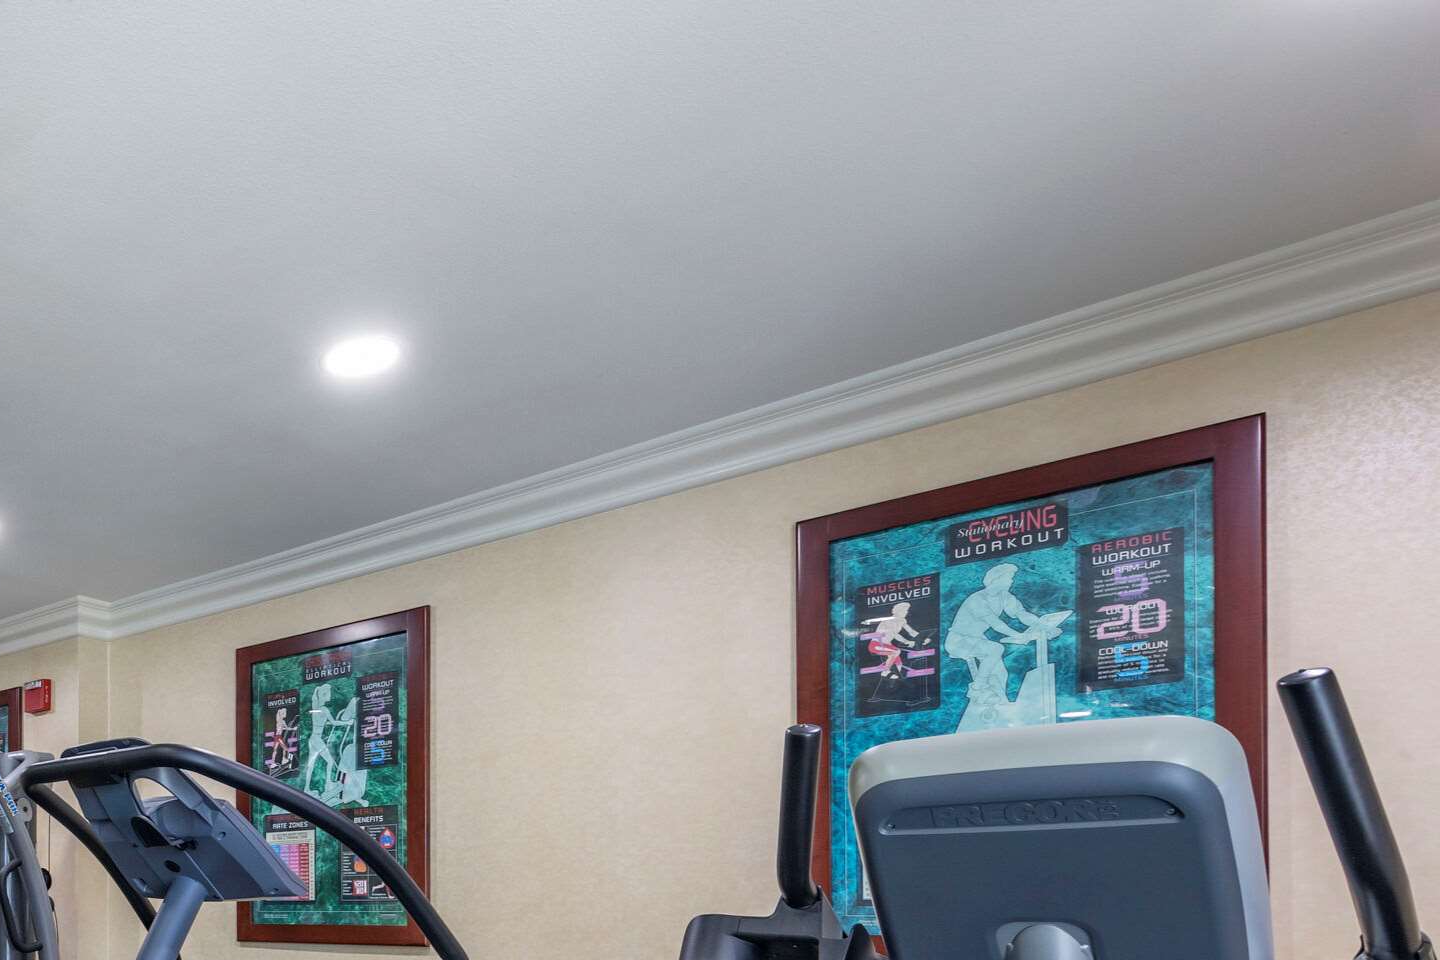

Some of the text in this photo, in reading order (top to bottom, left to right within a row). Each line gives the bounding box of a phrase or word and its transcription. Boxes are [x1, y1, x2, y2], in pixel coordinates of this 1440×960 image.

[955, 528, 1064, 558] WORKOUT
[1091, 531, 1172, 553] AEROBIC
[1092, 543, 1172, 565] WORKOUT
[866, 576, 932, 595] MUSCLES
[867, 587, 931, 605] INVOLVED
[1096, 598, 1167, 640] 20
[305, 665, 351, 680] WORKOUT
[364, 714, 392, 738] 20
